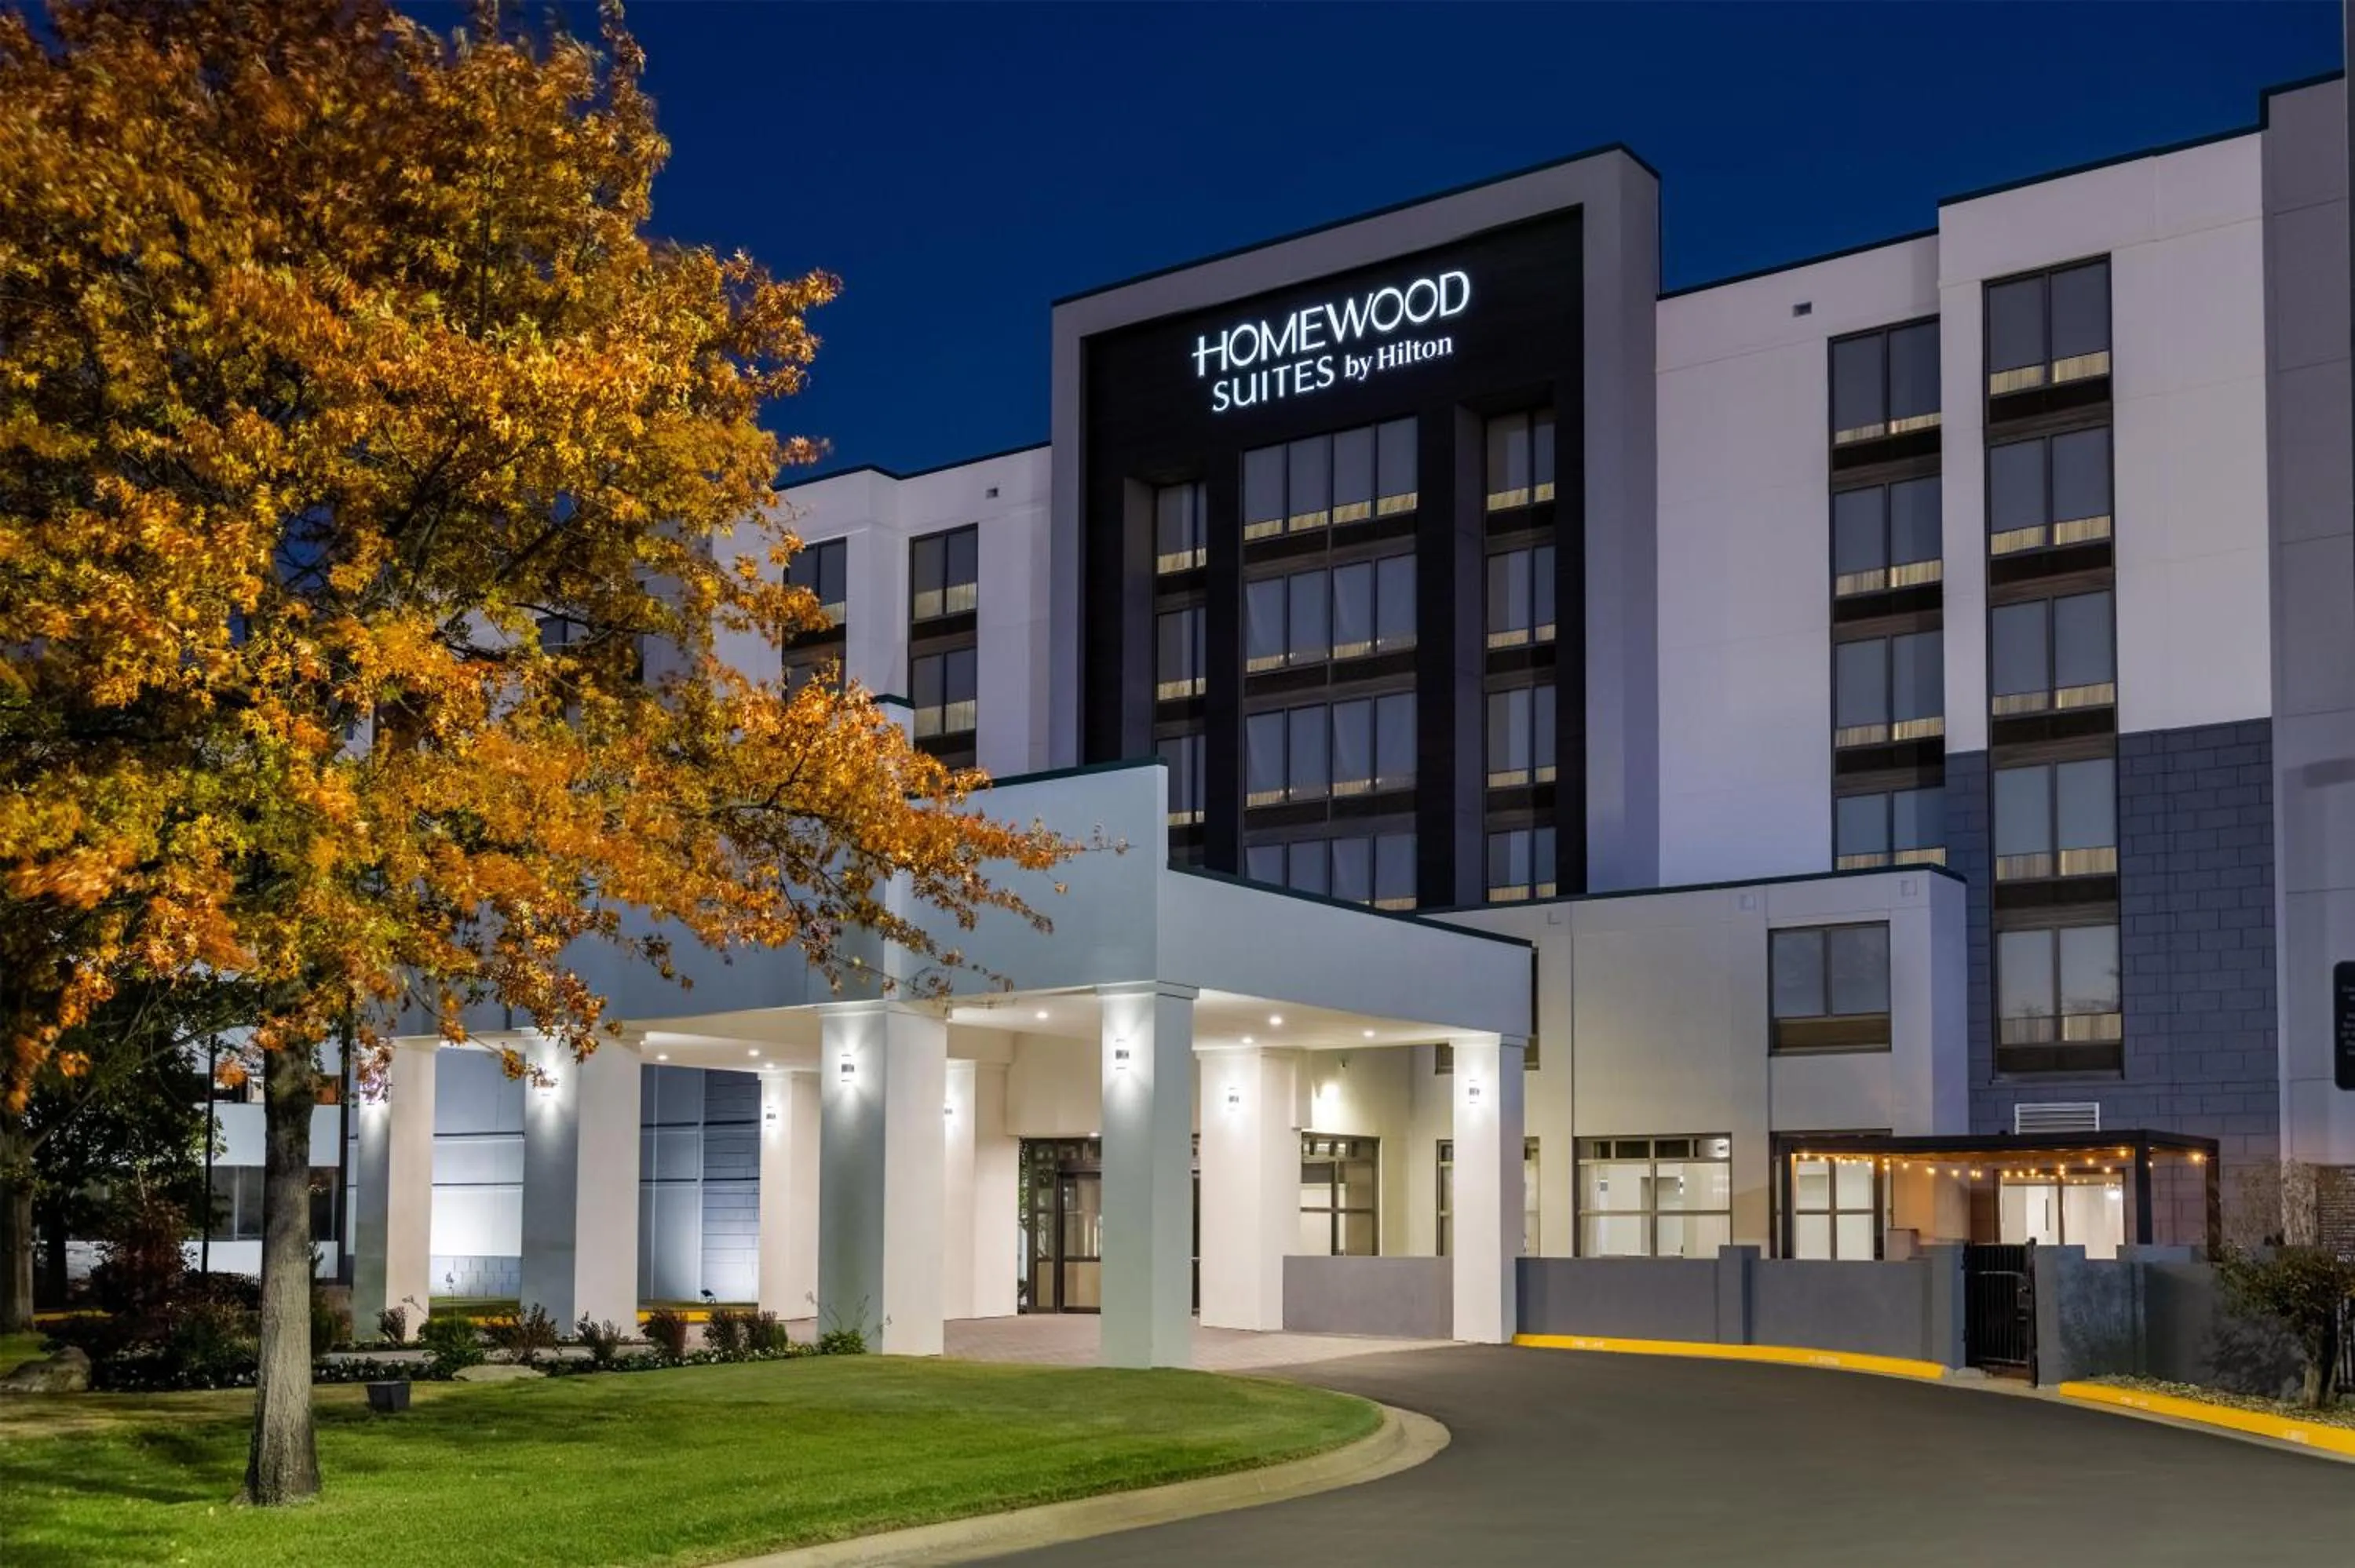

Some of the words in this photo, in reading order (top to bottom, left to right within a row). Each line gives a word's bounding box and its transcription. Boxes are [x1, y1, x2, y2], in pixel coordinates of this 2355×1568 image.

[1191, 270, 1471, 377] HOMEWOOD
[1212, 356, 1334, 412] SUITES
[1344, 354, 1373, 381] by
[1377, 337, 1454, 371] Hilton
